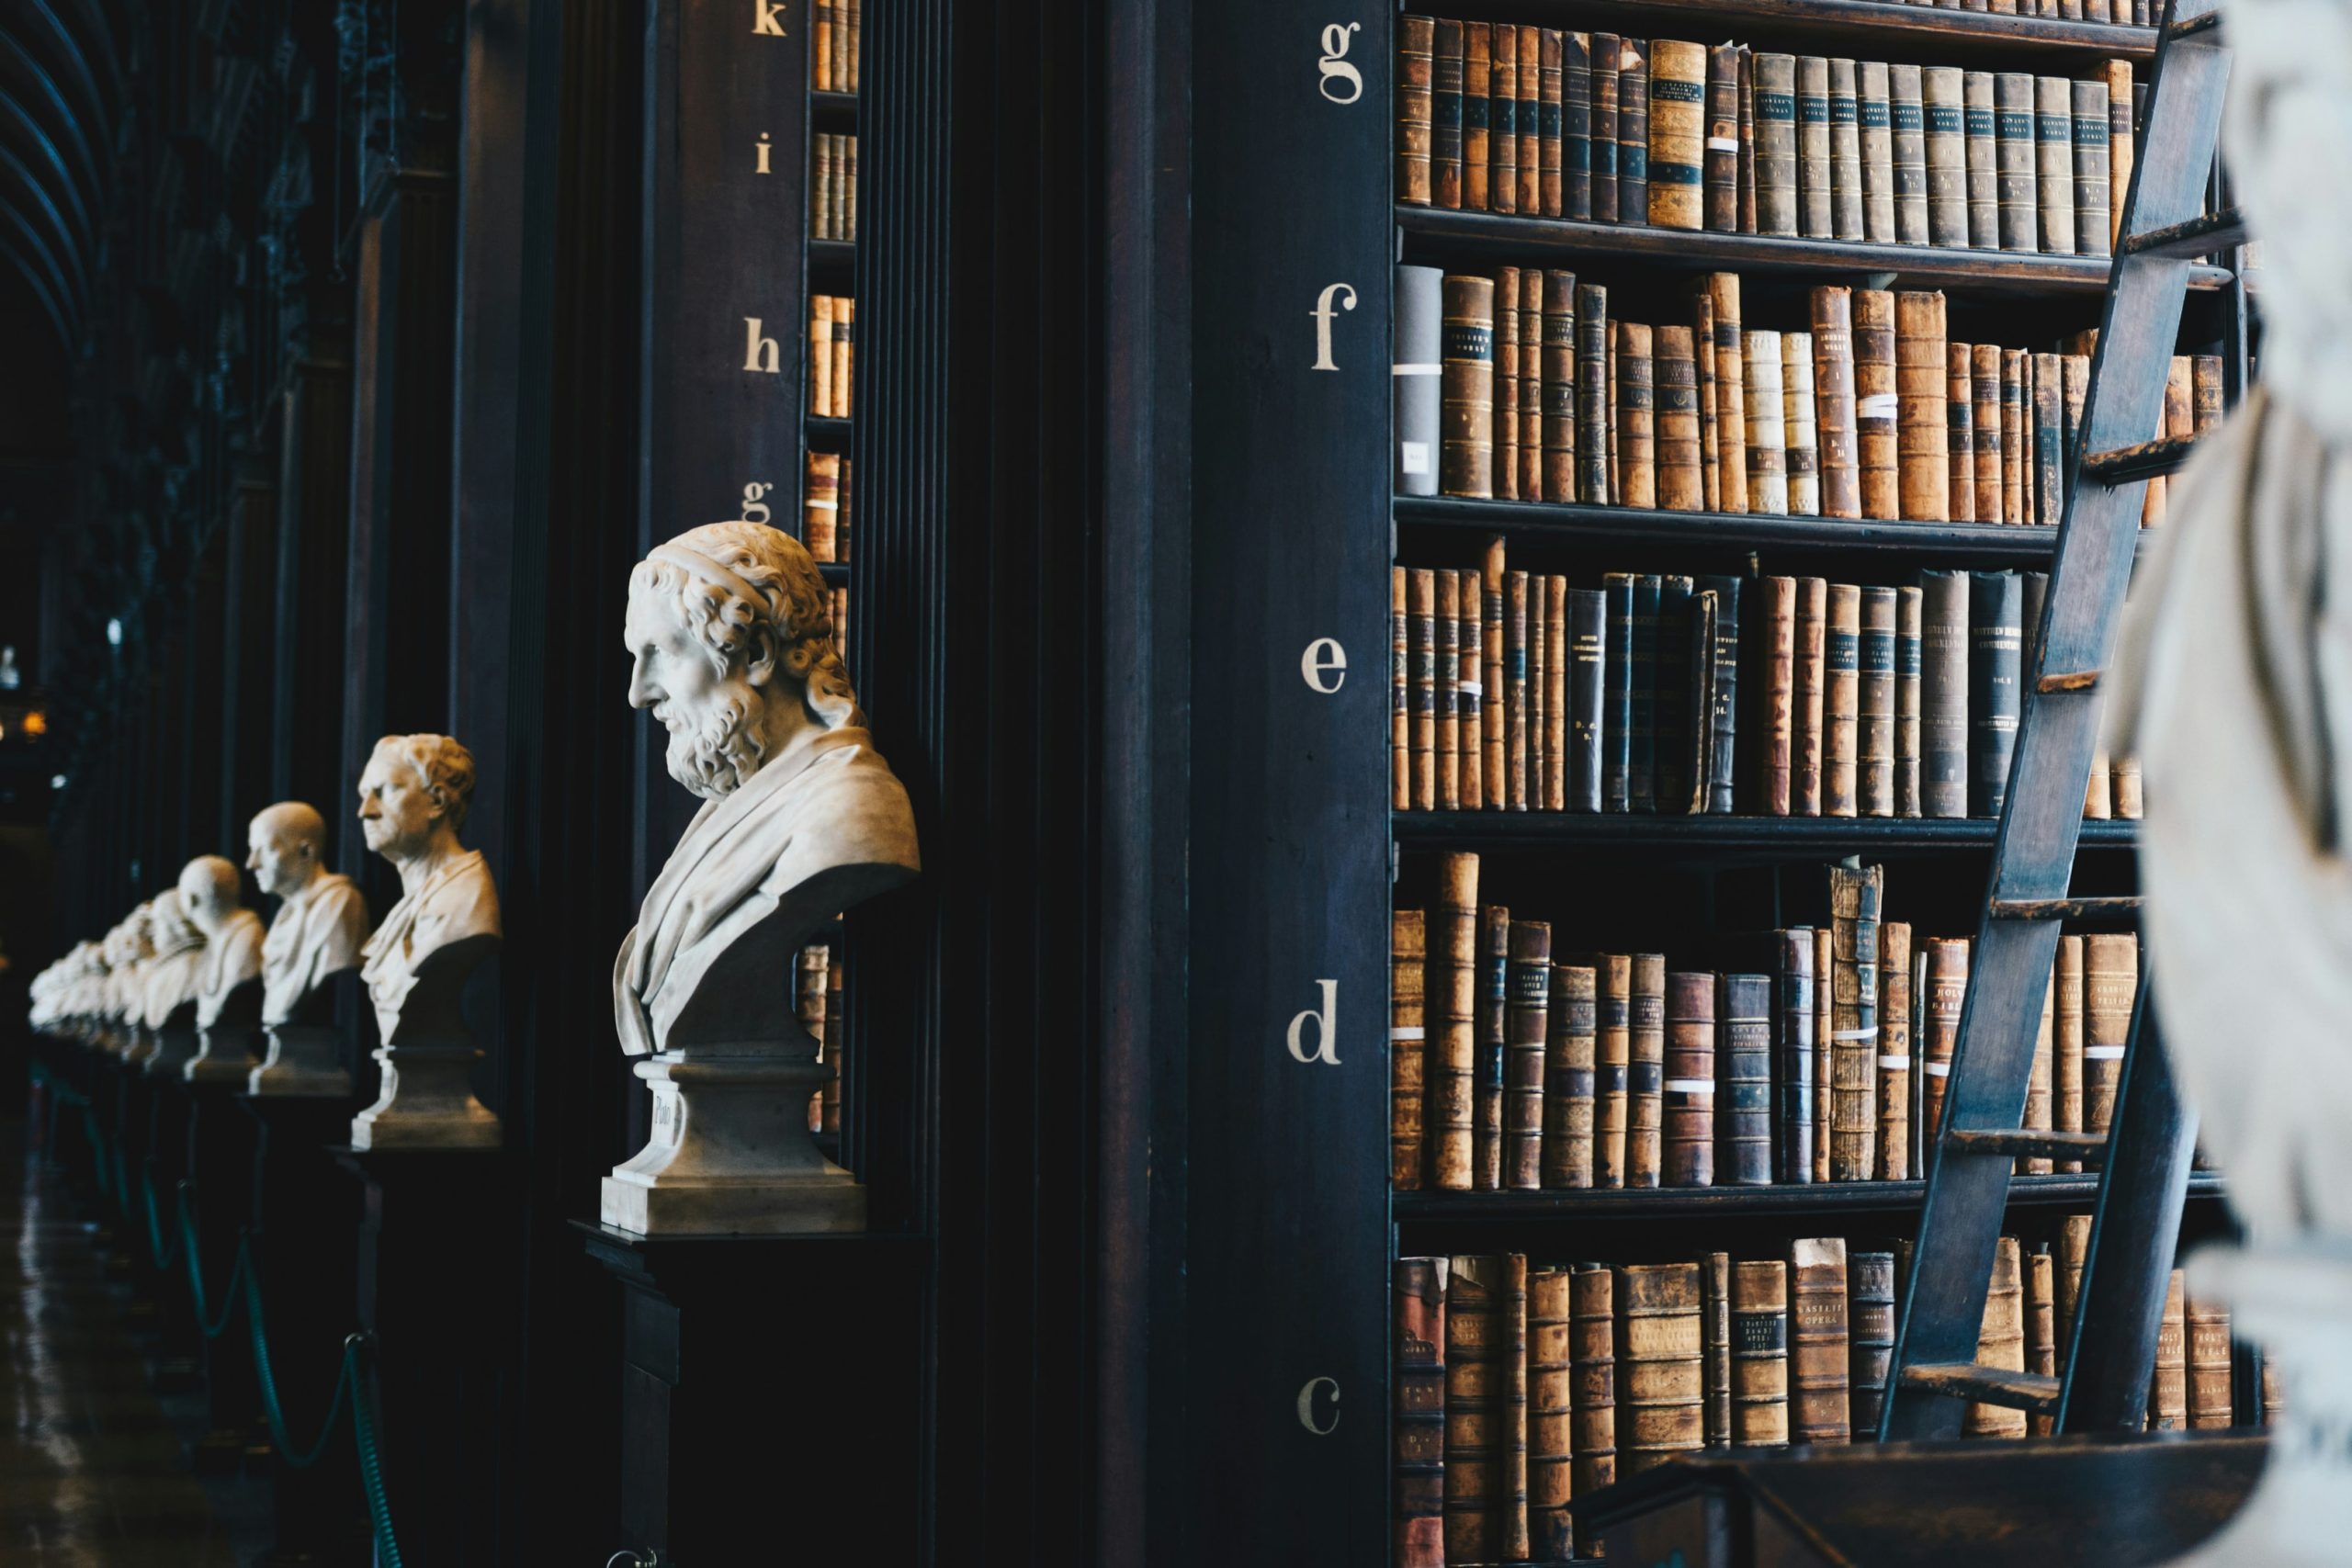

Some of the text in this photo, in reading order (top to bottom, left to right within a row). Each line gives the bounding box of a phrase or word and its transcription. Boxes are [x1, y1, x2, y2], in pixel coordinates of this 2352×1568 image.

[752, 0, 787, 37] k
[1318, 22, 1363, 105] g
[755, 131, 772, 175] i
[742, 317, 781, 374] h
[1310, 282, 1358, 371] f
[741, 482, 774, 525] g
[1301, 637, 1348, 694] e
[1287, 978, 1342, 1066] d
[1932, 1001, 1961, 1011] BIBL
[1804, 1317, 1838, 1325] OPERA
[2199, 1332, 2222, 1343] HOLY
[2197, 1346, 2227, 1356] BIBLE
[1297, 1377, 1340, 1435] c
